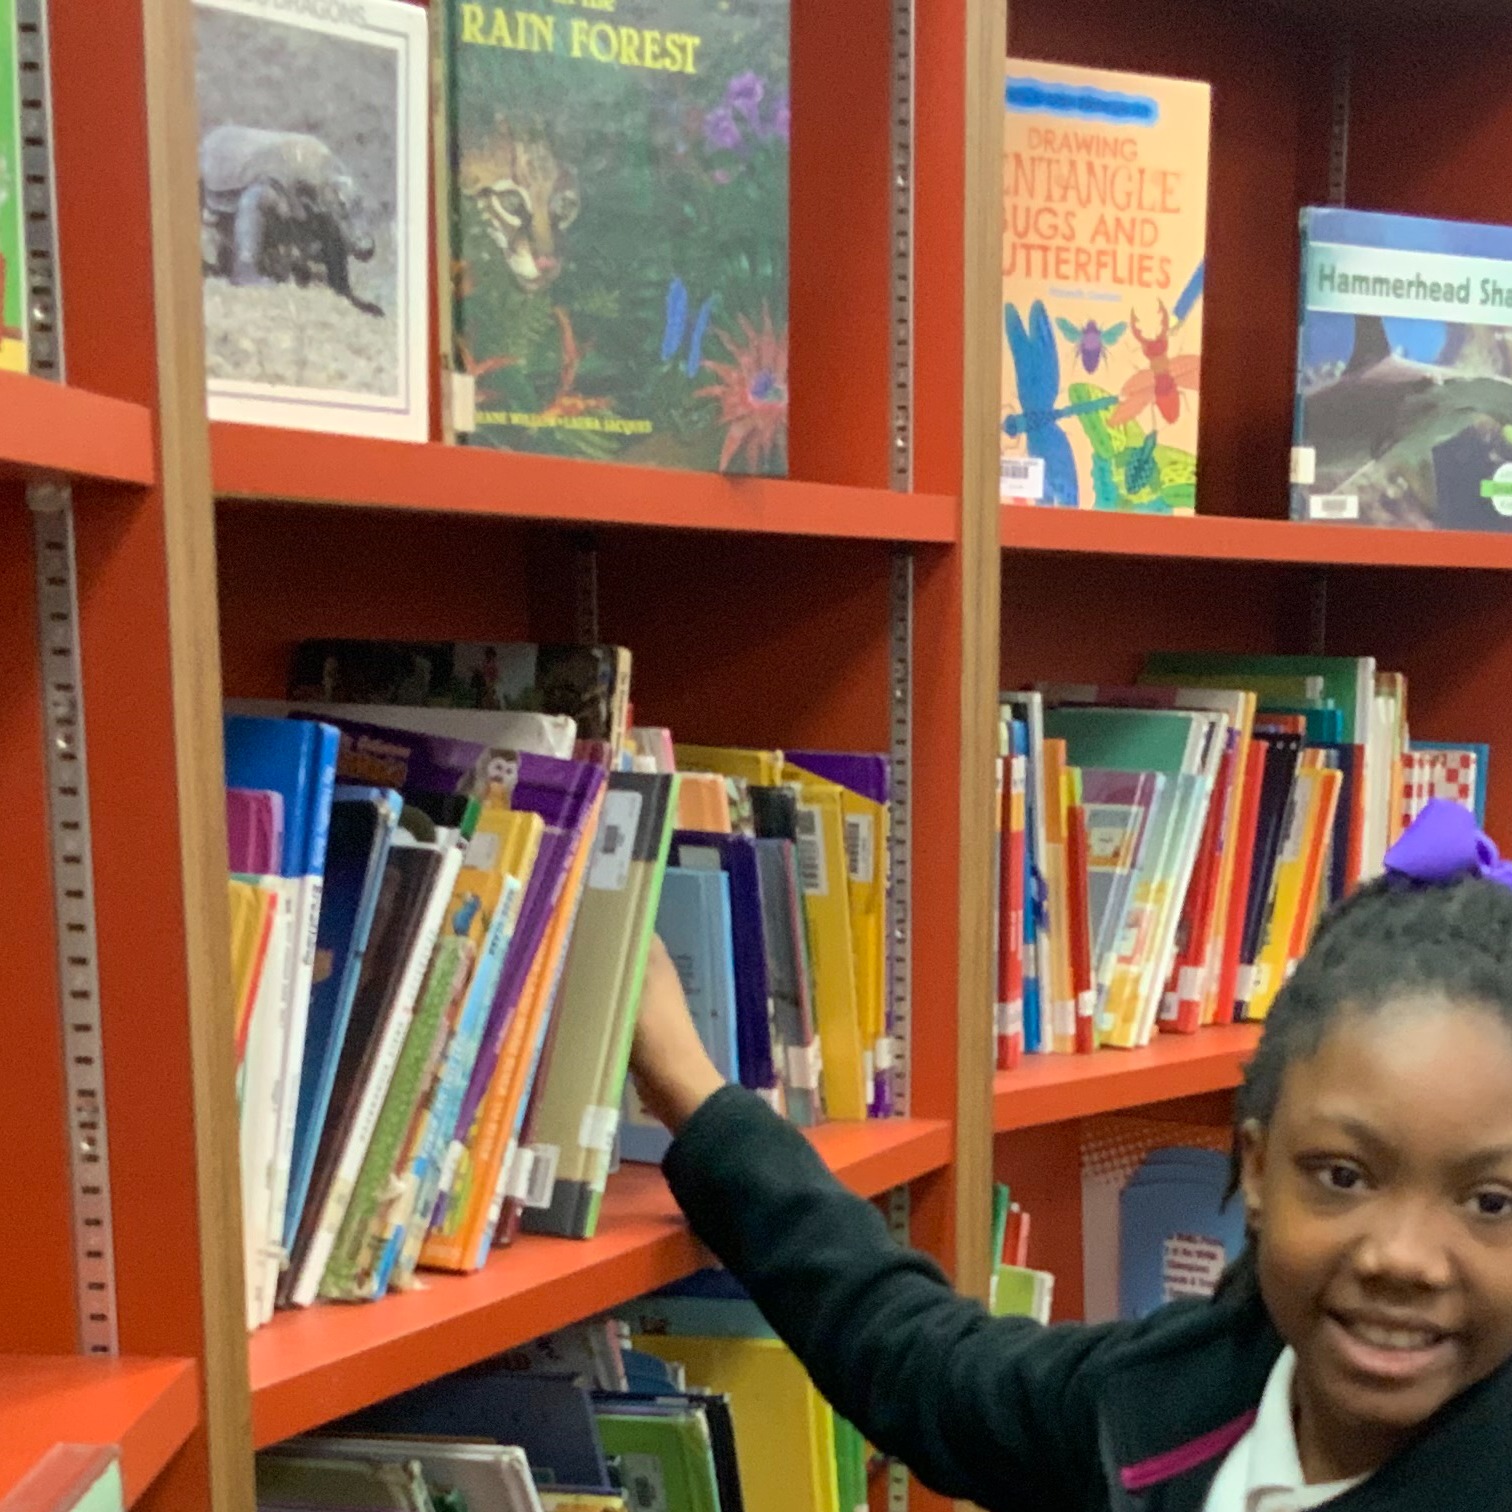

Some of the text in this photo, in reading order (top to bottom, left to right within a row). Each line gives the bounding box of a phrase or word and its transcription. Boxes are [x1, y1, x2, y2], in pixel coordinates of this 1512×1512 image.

[461, 3, 701, 74] RAIN FOREST
[1028, 126, 1139, 163] DRAWING
[1003, 152, 1183, 214] NTANGLE
[1001, 203, 1160, 248] UGS AND
[1002, 242, 1173, 290] UTTERFLIES
[1318, 263, 1471, 305] Hammerhead
